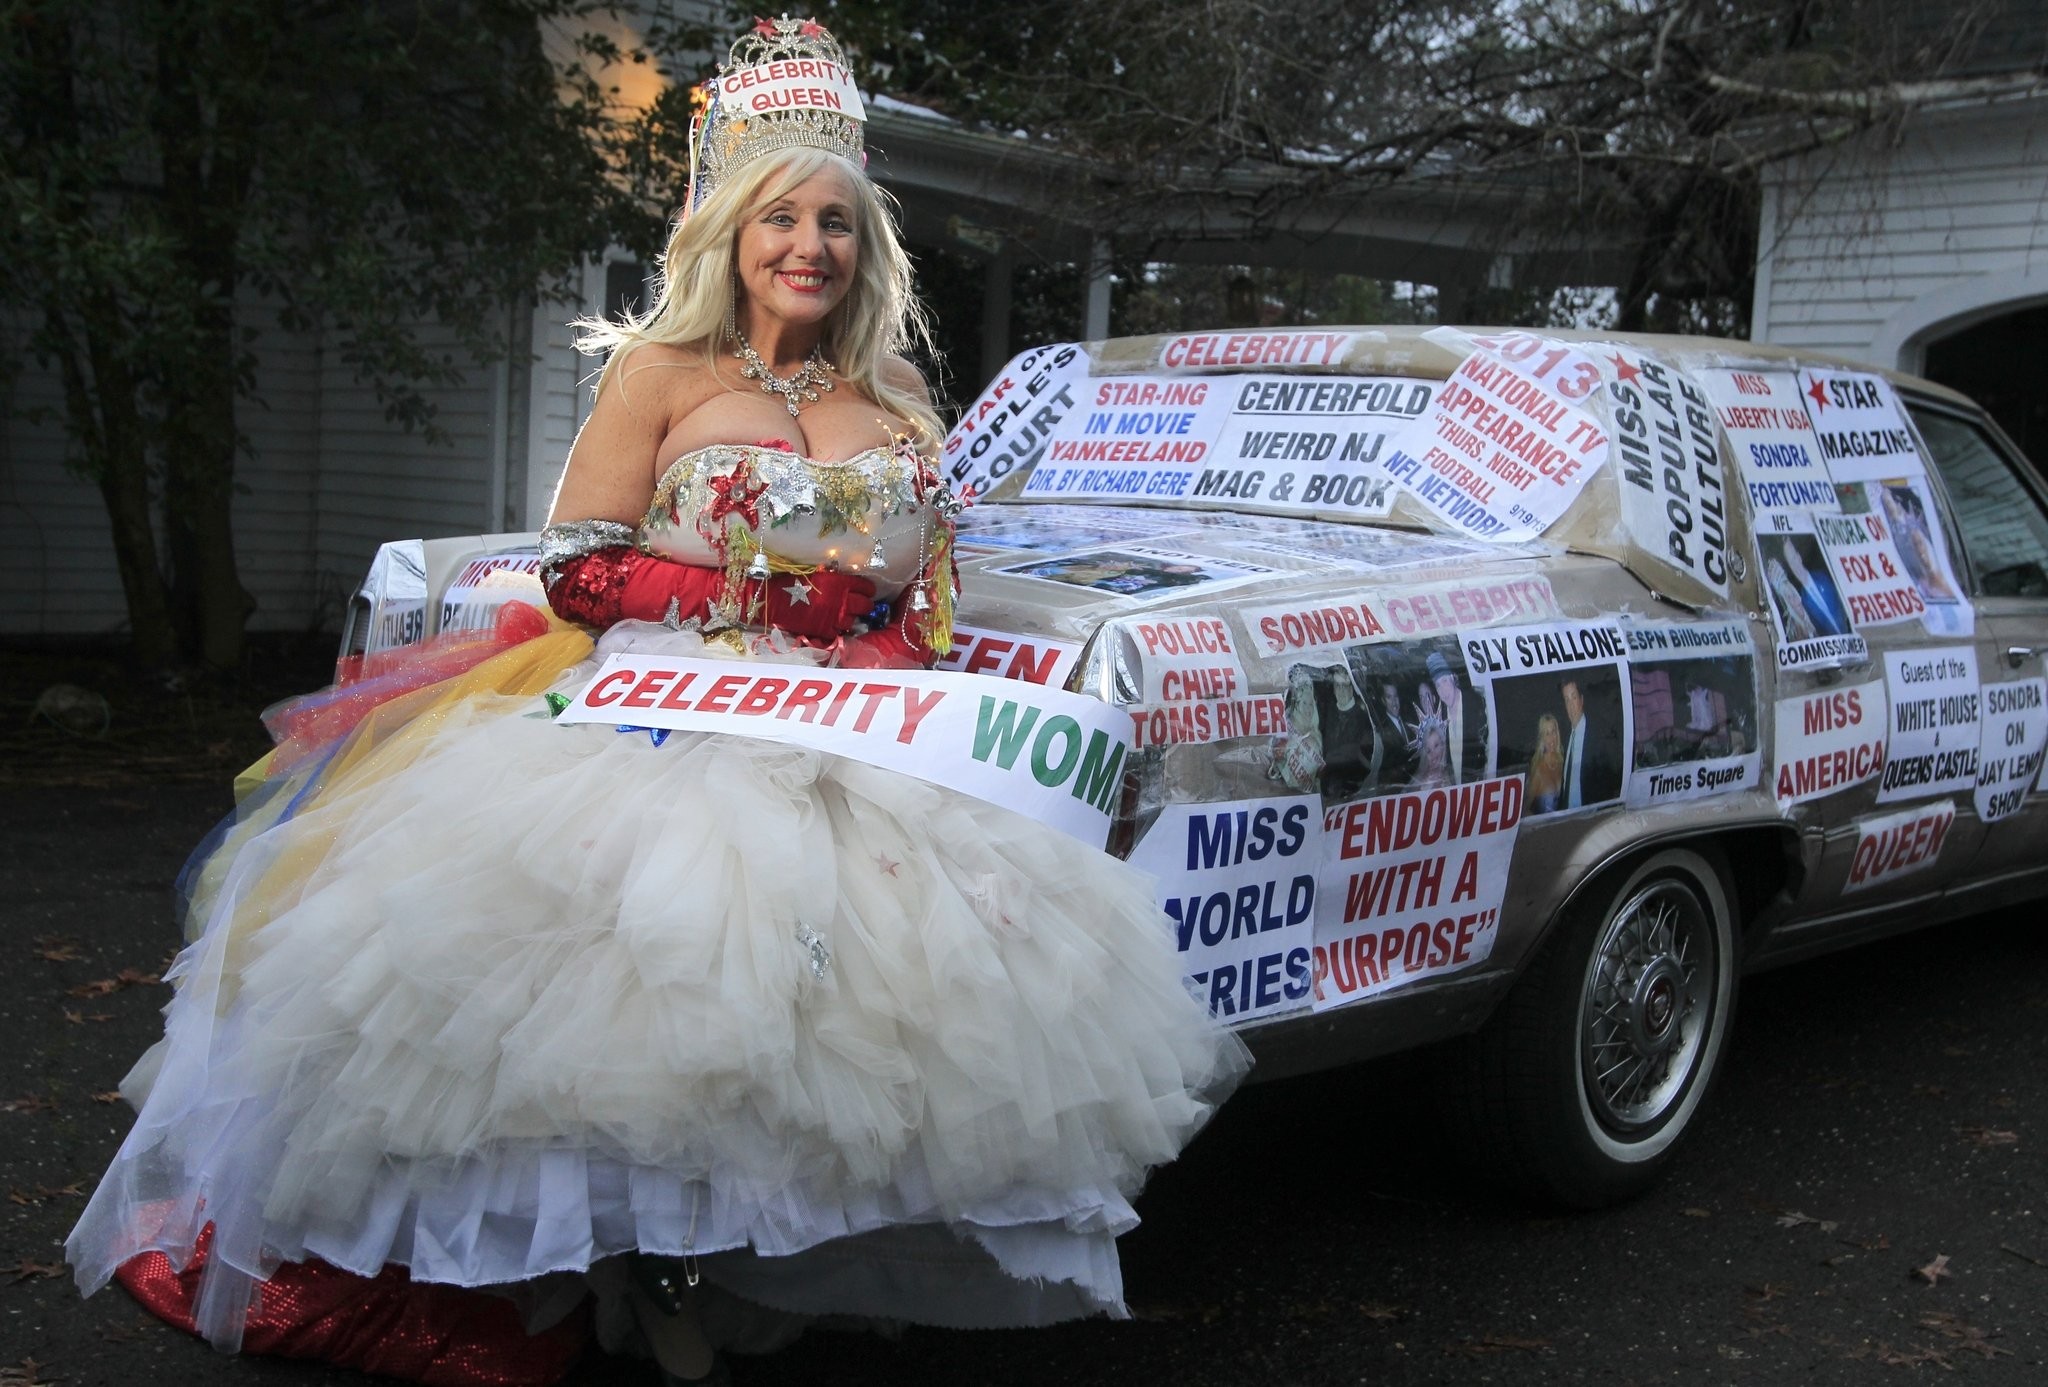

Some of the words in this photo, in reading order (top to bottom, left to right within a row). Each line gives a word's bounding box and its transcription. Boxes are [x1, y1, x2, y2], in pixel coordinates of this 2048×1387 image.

[724, 61, 849, 94] CELEBRITY
[752, 89, 841, 111] QUEEN
[1165, 334, 1346, 367] CELEBRITY
[1096, 383, 1208, 406] STAR-ING
[1238, 381, 1432, 415] CENTERFOLD
[1731, 373, 1771, 396] MISS
[1829, 380, 1883, 409] STAR
[945, 347, 1077, 487] EOPLE'S
[946, 377, 1016, 456] STAR
[1460, 354, 1568, 432] NATIONAL
[1565, 419, 1609, 455] TV
[1718, 407, 1781, 429] LIBERTY
[1783, 408, 1811, 430] USA
[972, 382, 1075, 496] COURT
[1085, 412, 1109, 434] IN
[1115, 412, 1196, 435] MOVIE
[1435, 381, 1582, 487] APPEARANCE
[1610, 382, 1654, 493] MISS
[1050, 440, 1207, 463] YANKEELAND
[1239, 431, 1337, 461] WEIRD
[1340, 431, 1386, 463] NJ
[1750, 443, 1812, 468] SONDRA
[1820, 430, 1915, 459] MAGAZINE
[1422, 446, 1496, 505] FOOTBALL
[1486, 451, 1538, 491] NIGHT
[1639, 359, 1694, 568] POPULAR
[1026, 469, 1055, 492] DIR.
[1056, 470, 1081, 491] BY
[1078, 470, 1146, 494] RICHARD
[1147, 471, 1194, 496] GERE
[1193, 469, 1265, 499] MAG
[1269, 472, 1295, 502] &
[1302, 474, 1394, 508] BOOK
[1383, 450, 1422, 486] NFL
[1416, 474, 1511, 539] NETWORK
[1677, 378, 1726, 585] CULTURE
[1749, 482, 1836, 508] FORTUNATO
[1510, 504, 1547, 533] 9/19/13
[1772, 515, 1793, 531] NFL
[1819, 517, 1869, 546] SONDRA
[1865, 515, 1889, 541] ON
[1840, 554, 1879, 583] FOX
[1879, 552, 1898, 577] &
[1260, 604, 1386, 653] SONDRA
[1387, 581, 1552, 634] CELEBRITY
[1848, 586, 1924, 624] FRIENDS
[1137, 619, 1232, 656] POLICE
[1467, 637, 1513, 674] SLY
[1515, 627, 1626, 669] STALLONE
[1626, 629, 1668, 650] ESPN
[1669, 626, 1732, 648] Billboard
[1778, 638, 1866, 667] COMMISSIONER
[1162, 667, 1236, 701] CHIEF
[1901, 661, 1935, 684] Guest
[1936, 657, 1950, 680] of
[1951, 658, 1966, 679] the
[584, 669, 947, 745] CELEBRITY
[1803, 689, 1862, 736] MISS
[1896, 698, 1936, 733] WHITE
[1939, 693, 1978, 727] HOUSE
[1989, 684, 2042, 714] SONDRA
[1129, 703, 1210, 749] TOMS
[1216, 698, 1287, 738] RIVER
[2005, 721, 2025, 747] ON
[1650, 773, 1692, 797] Times
[1697, 763, 1745, 794] Square
[1777, 740, 1883, 801] AMERICA
[1883, 755, 1935, 793] QUEENS
[1935, 747, 1979, 781] CASTLE
[1978, 758, 2006, 787] JAY
[1324, 777, 1522, 861] "ENDOWED
[1187, 804, 1309, 870] MISS
[1850, 811, 1954, 886] QUEEN
[1343, 856, 1446, 924] WITH
[1451, 851, 1479, 904] A
[1312, 908, 1496, 1002] PURPOSE"
